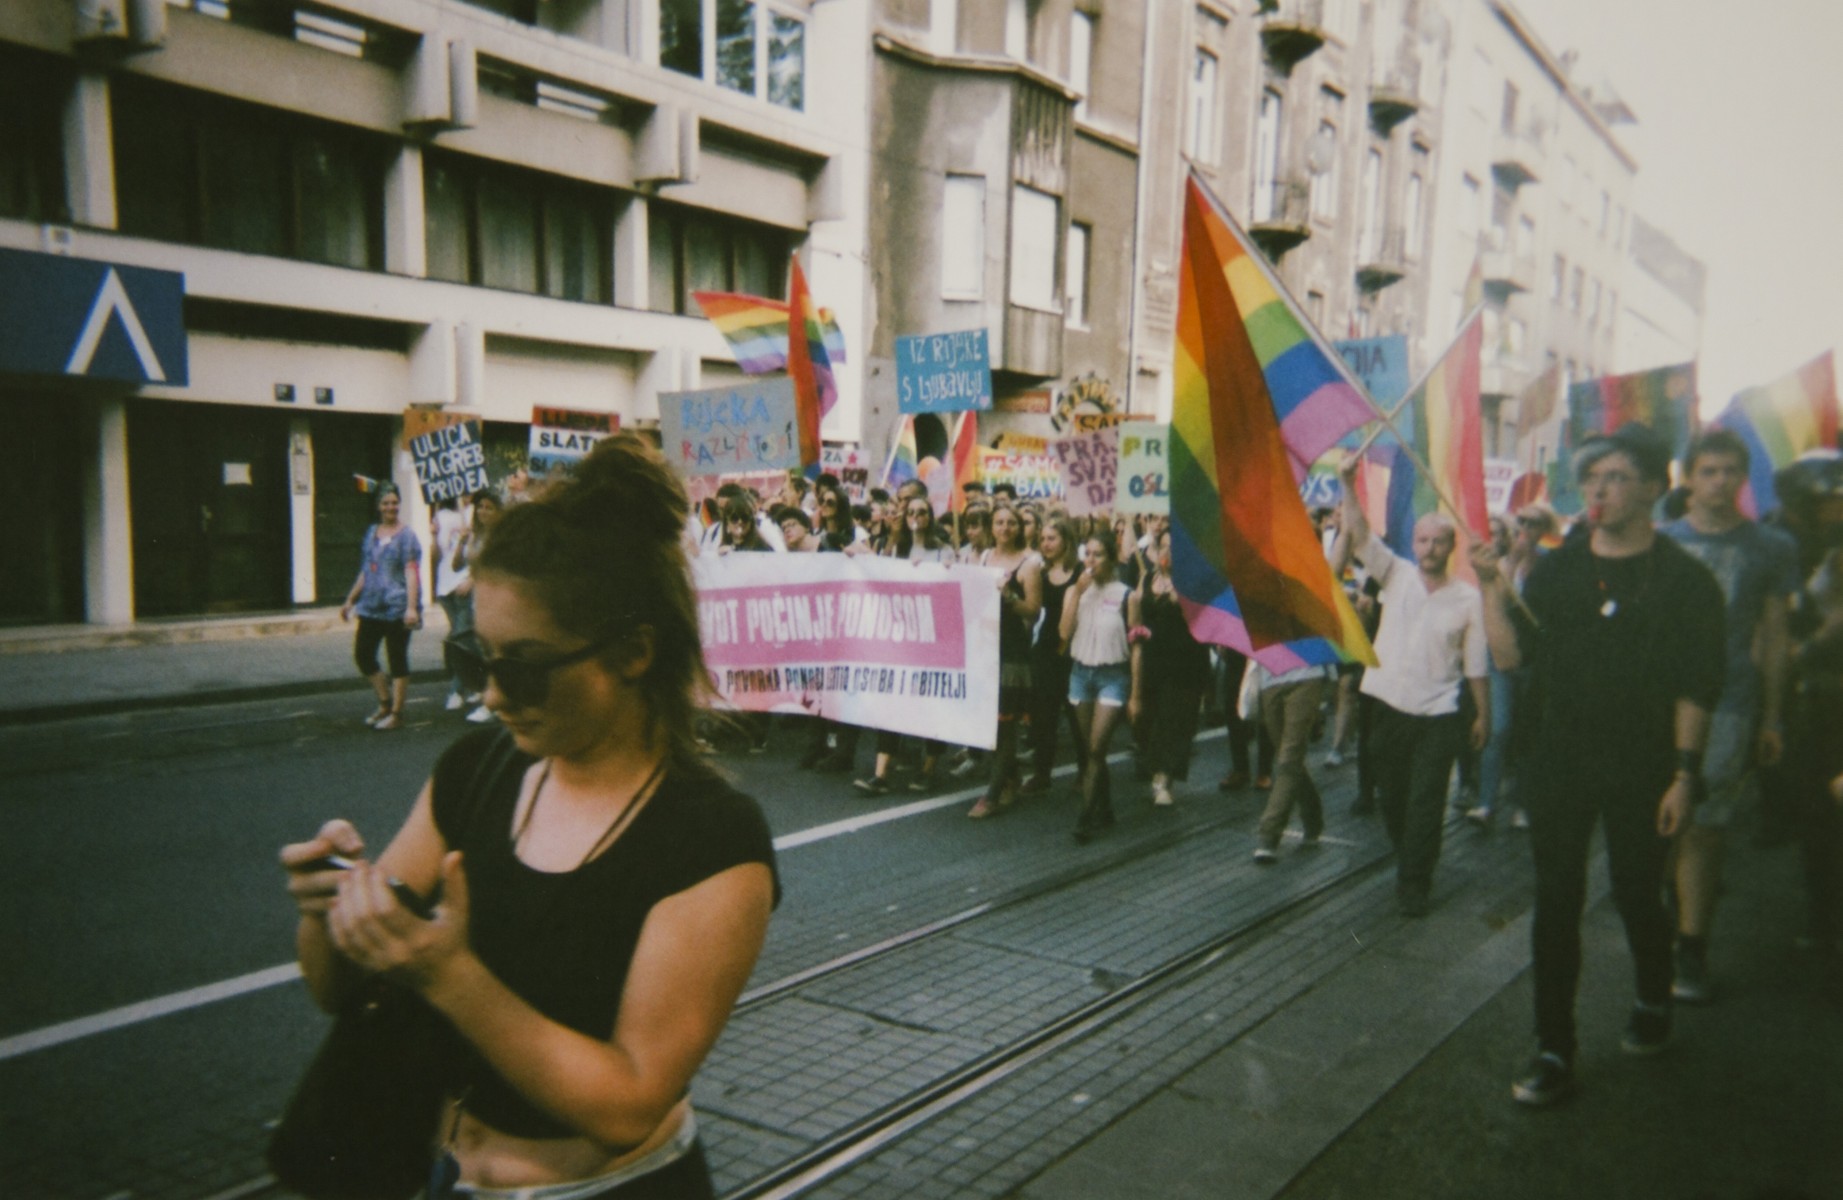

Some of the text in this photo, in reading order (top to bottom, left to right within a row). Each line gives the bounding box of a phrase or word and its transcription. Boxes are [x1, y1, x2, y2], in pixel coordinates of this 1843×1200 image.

[413, 422, 472, 458] ULICA
[539, 433, 598, 450] SLAT
[416, 443, 485, 484] ZAGREB
[424, 467, 490, 503] PRIDEA
[1299, 472, 1335, 503] YS
[699, 590, 936, 646] VOT POČINJE PONOSOM
[899, 668, 906, 695] I
[911, 669, 966, 699] OBITELJI
